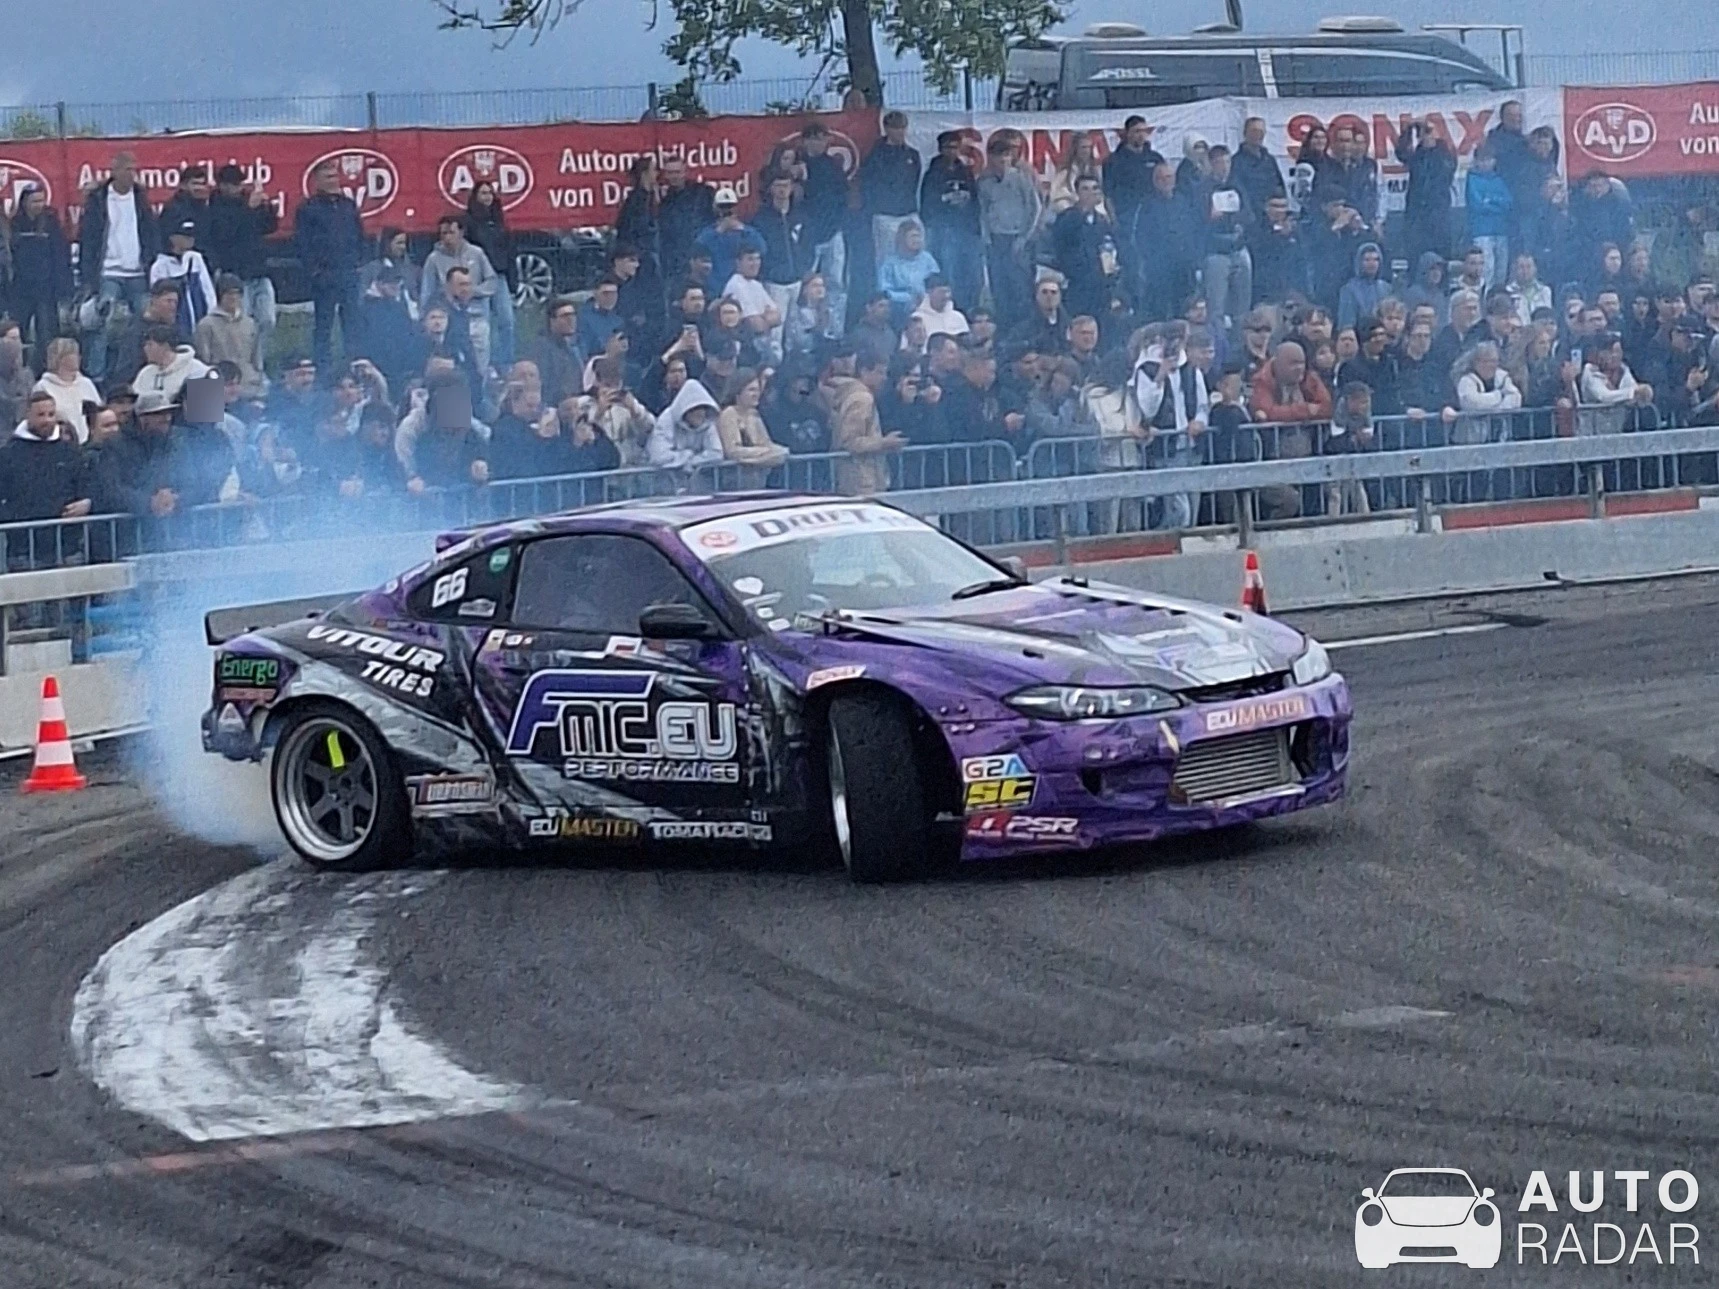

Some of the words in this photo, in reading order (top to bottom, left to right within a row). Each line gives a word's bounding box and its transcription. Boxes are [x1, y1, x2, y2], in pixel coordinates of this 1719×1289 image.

[450, 164, 526, 195] AD
[549, 188, 594, 208] von
[306, 624, 444, 673] VITOUR
[360, 660, 434, 697] TIRES
